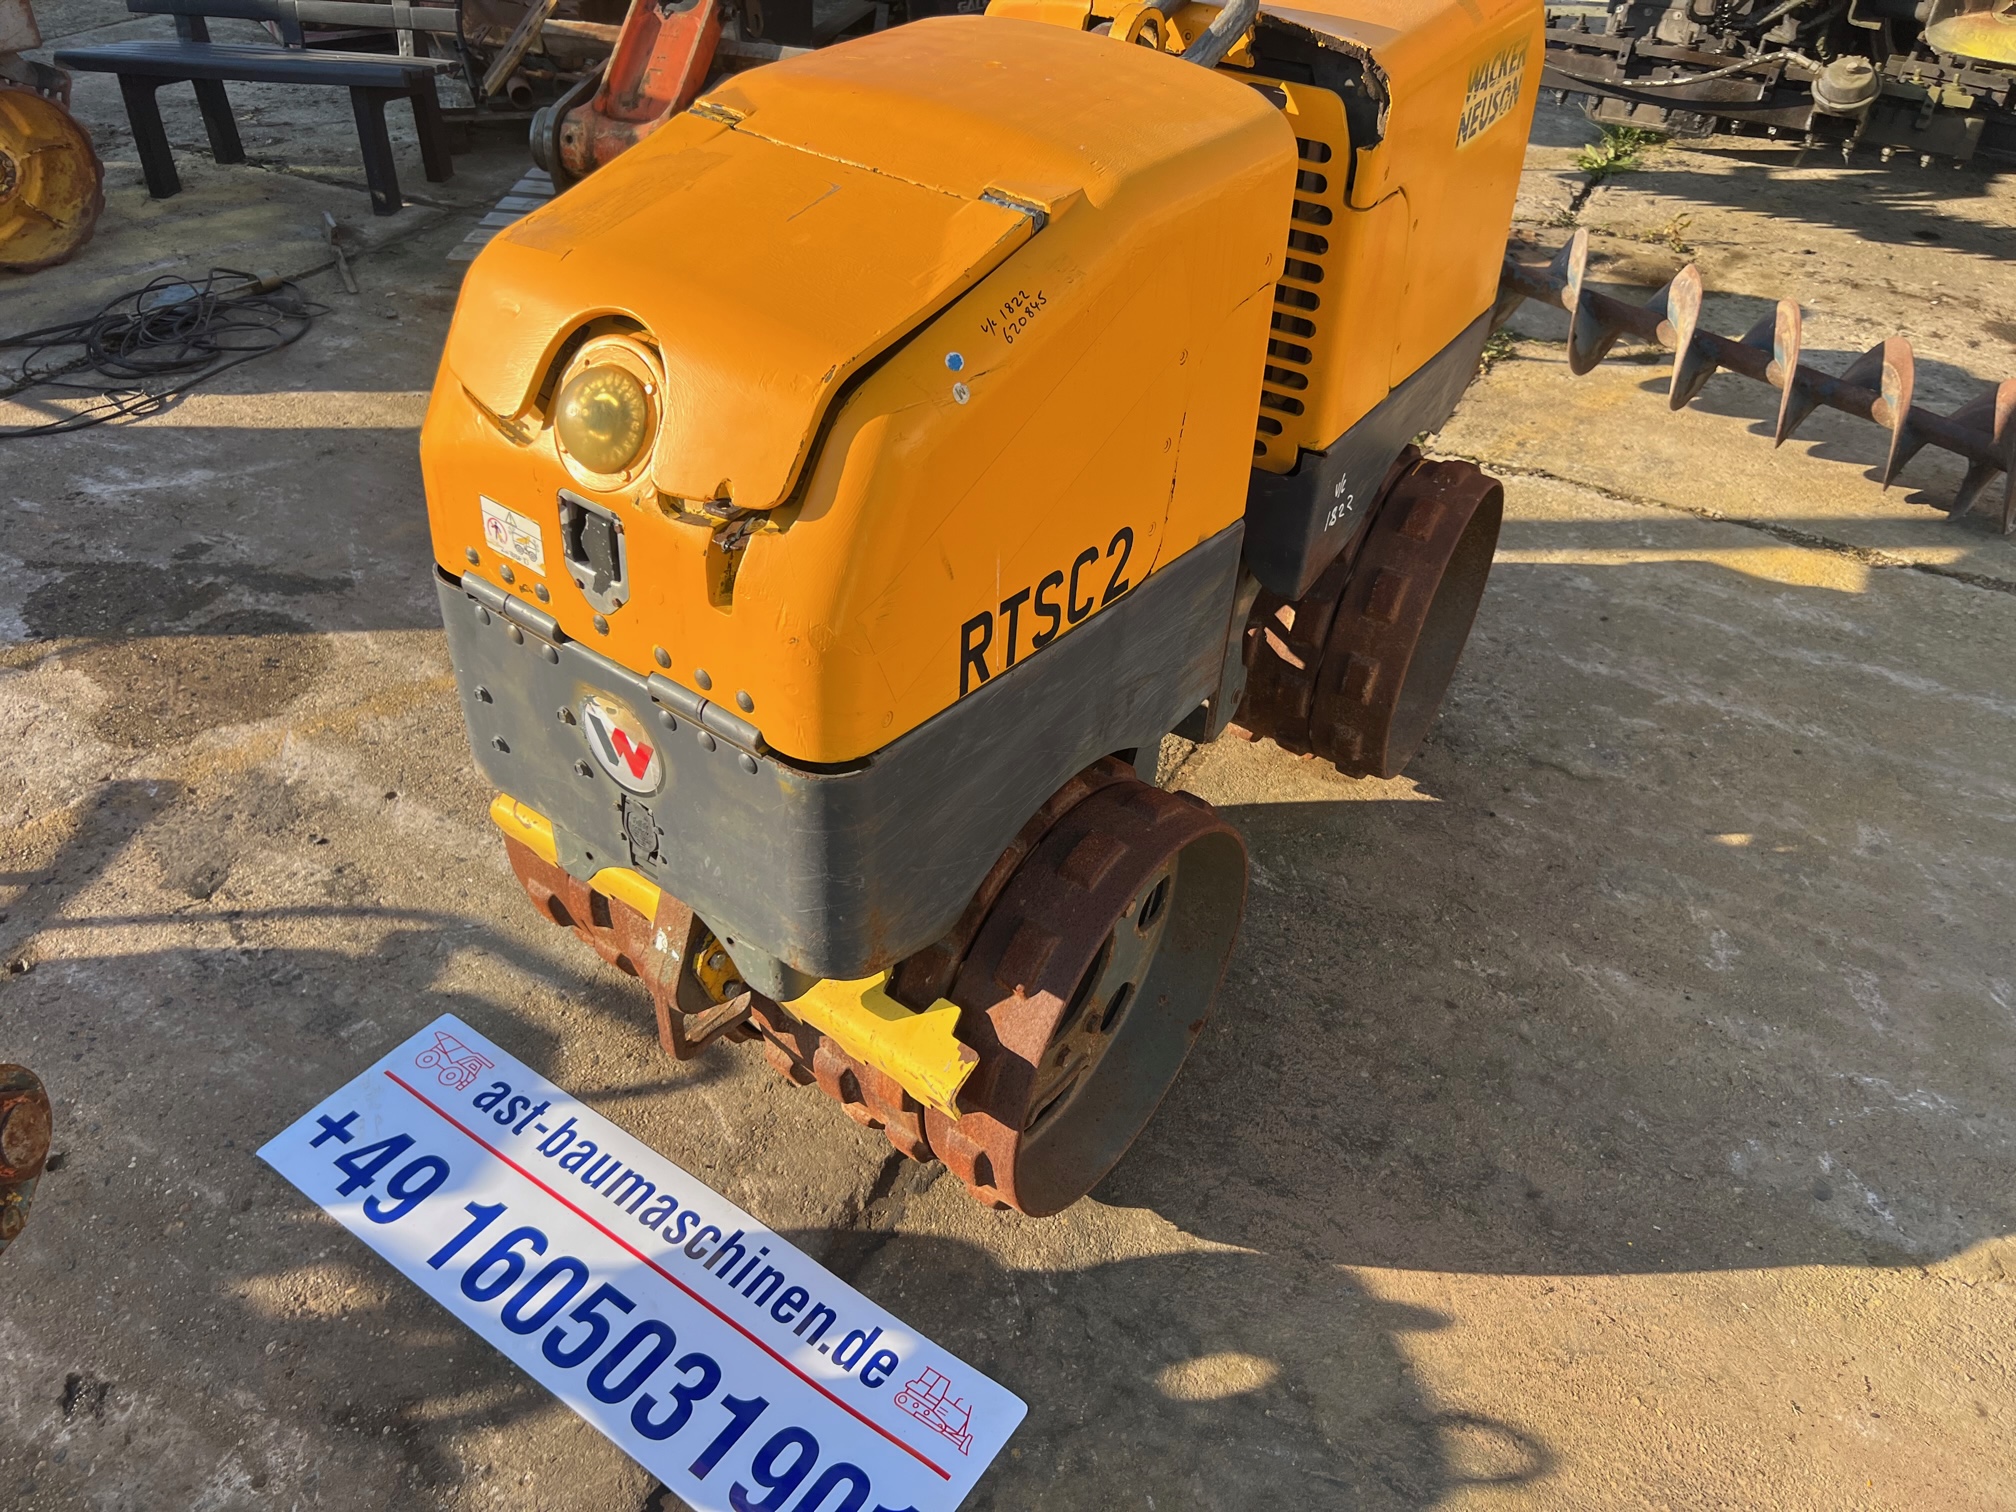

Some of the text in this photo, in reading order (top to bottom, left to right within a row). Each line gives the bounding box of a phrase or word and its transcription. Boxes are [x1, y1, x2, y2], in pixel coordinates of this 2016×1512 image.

[1000, 290, 1030, 320] 1822
[1003, 290, 1047, 344] 620845
[1324, 494, 1354, 532] 1822
[472, 1081, 900, 1389] ast-baumaschinen.de
[308, 1110, 920, 1512] +49 160503190
